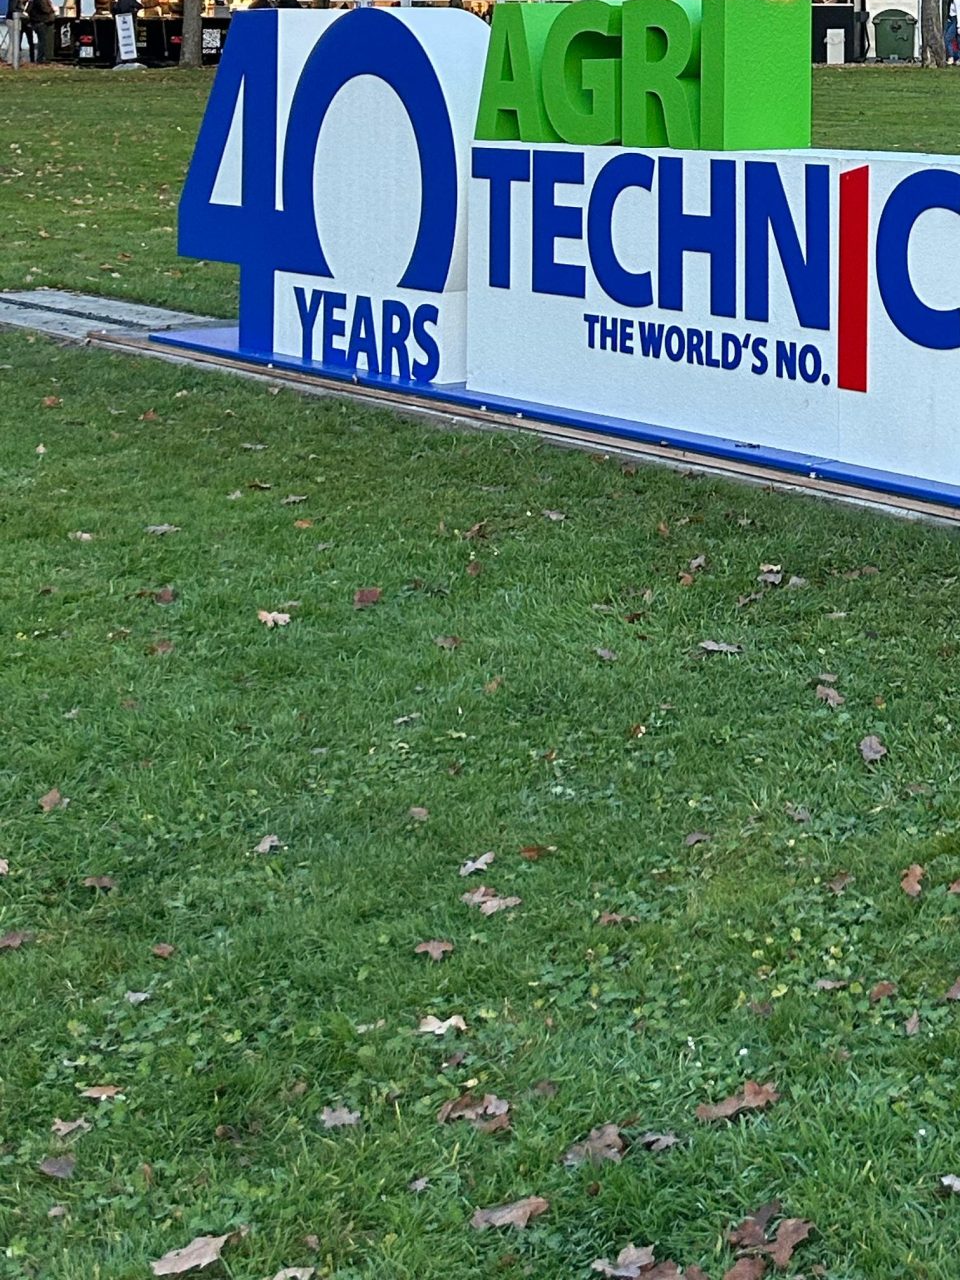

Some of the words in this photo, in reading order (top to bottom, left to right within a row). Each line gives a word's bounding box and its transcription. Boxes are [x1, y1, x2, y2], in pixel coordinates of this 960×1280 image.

[177, 6, 459, 356] 40
[293, 285, 440, 383] YEARS
[583, 312, 635, 356] THE
[637, 320, 769, 376] WORLD'S
[775, 339, 831, 386] NO.
